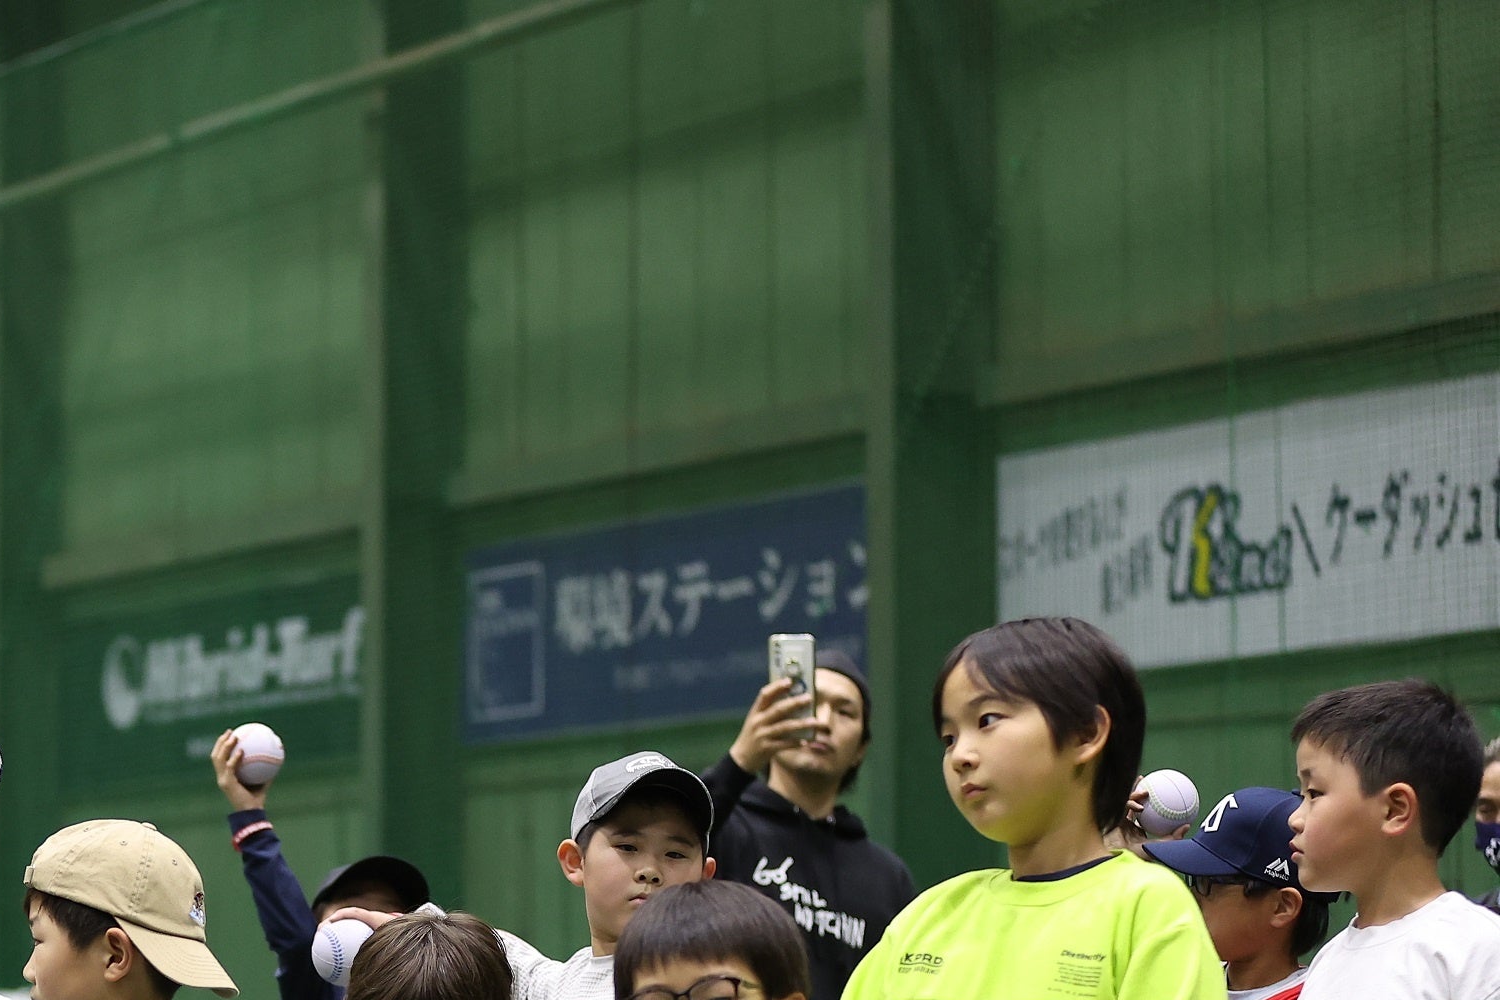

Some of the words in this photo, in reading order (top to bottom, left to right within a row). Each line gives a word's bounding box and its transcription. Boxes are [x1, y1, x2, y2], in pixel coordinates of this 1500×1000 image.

[1325, 455, 1500, 565] ケーダッシュ
